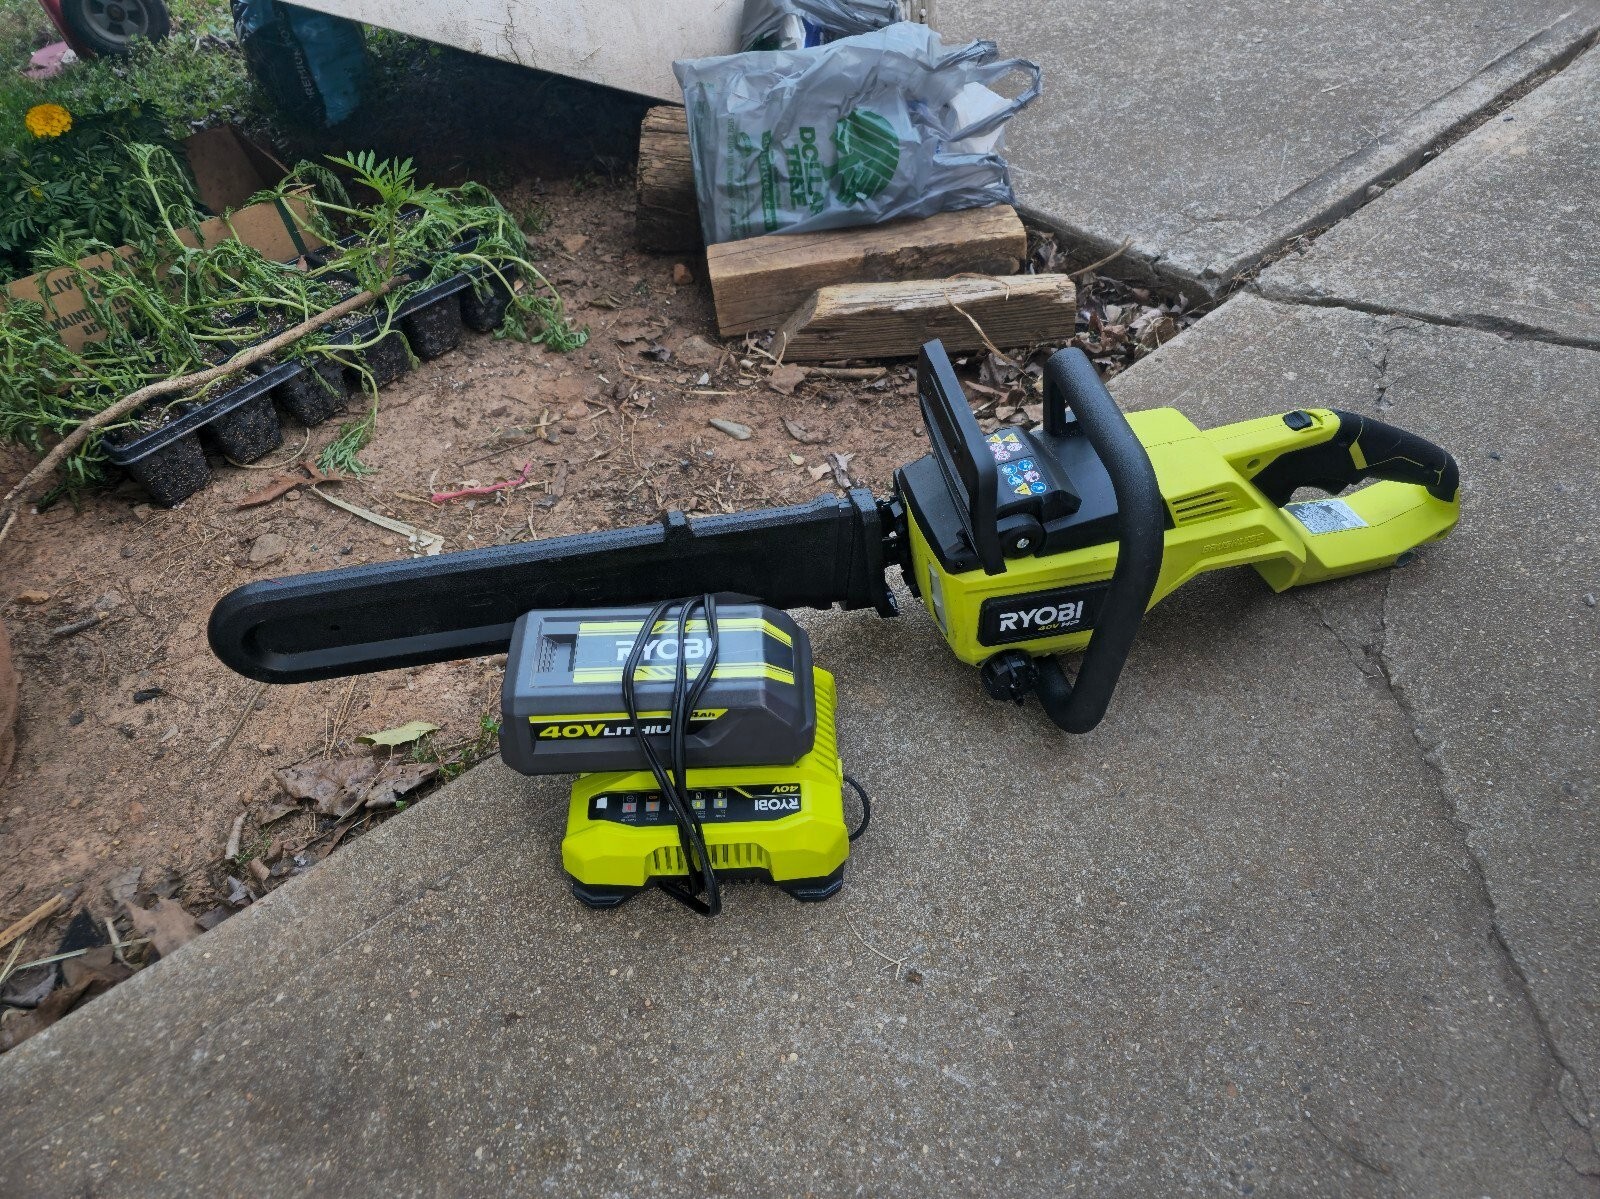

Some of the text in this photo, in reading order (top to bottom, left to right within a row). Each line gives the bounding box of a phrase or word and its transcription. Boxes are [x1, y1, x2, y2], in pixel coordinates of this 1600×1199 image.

[999, 600, 1084, 632] RYOBI
[1037, 623, 1060, 631] 40V
[615, 637, 713, 661] RYOBI
[603, 723, 671, 737] LITHIU
[771, 785, 799, 793] 40V
[754, 797, 800, 811] RYOBI
